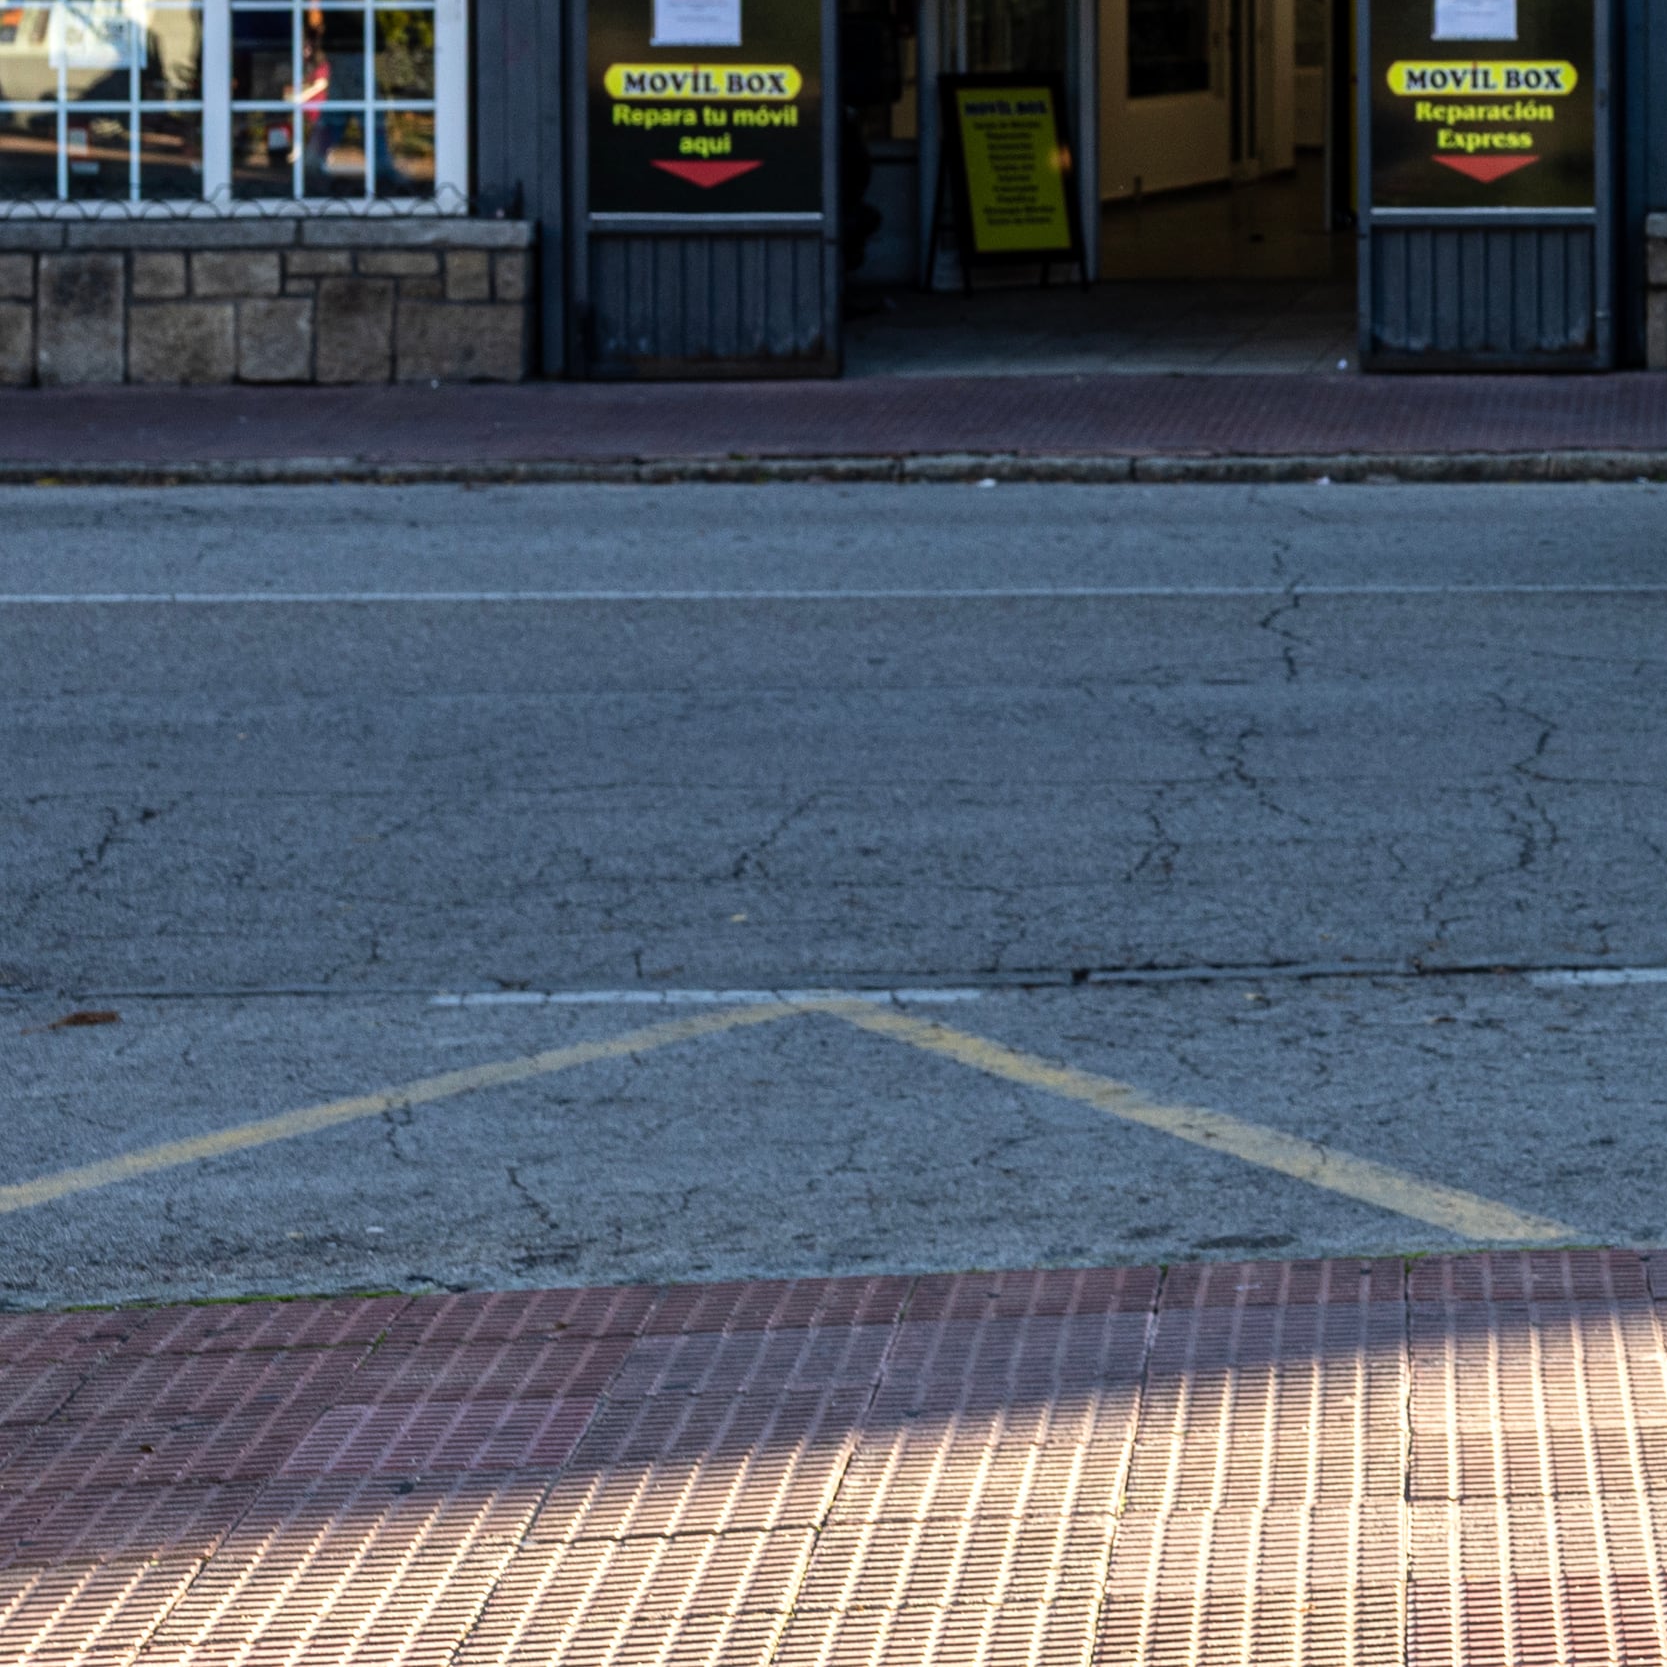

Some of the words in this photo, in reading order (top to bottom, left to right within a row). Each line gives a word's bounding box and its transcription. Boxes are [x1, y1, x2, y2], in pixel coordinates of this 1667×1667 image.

[725, 72, 786, 95] BOX
[1504, 68, 1563, 90] BOX
[612, 103, 698, 130] Repara
[703, 106, 728, 127] tu
[733, 105, 799, 127] móvil
[1414, 100, 1556, 126] Reparación
[1436, 129, 1534, 154] Express
